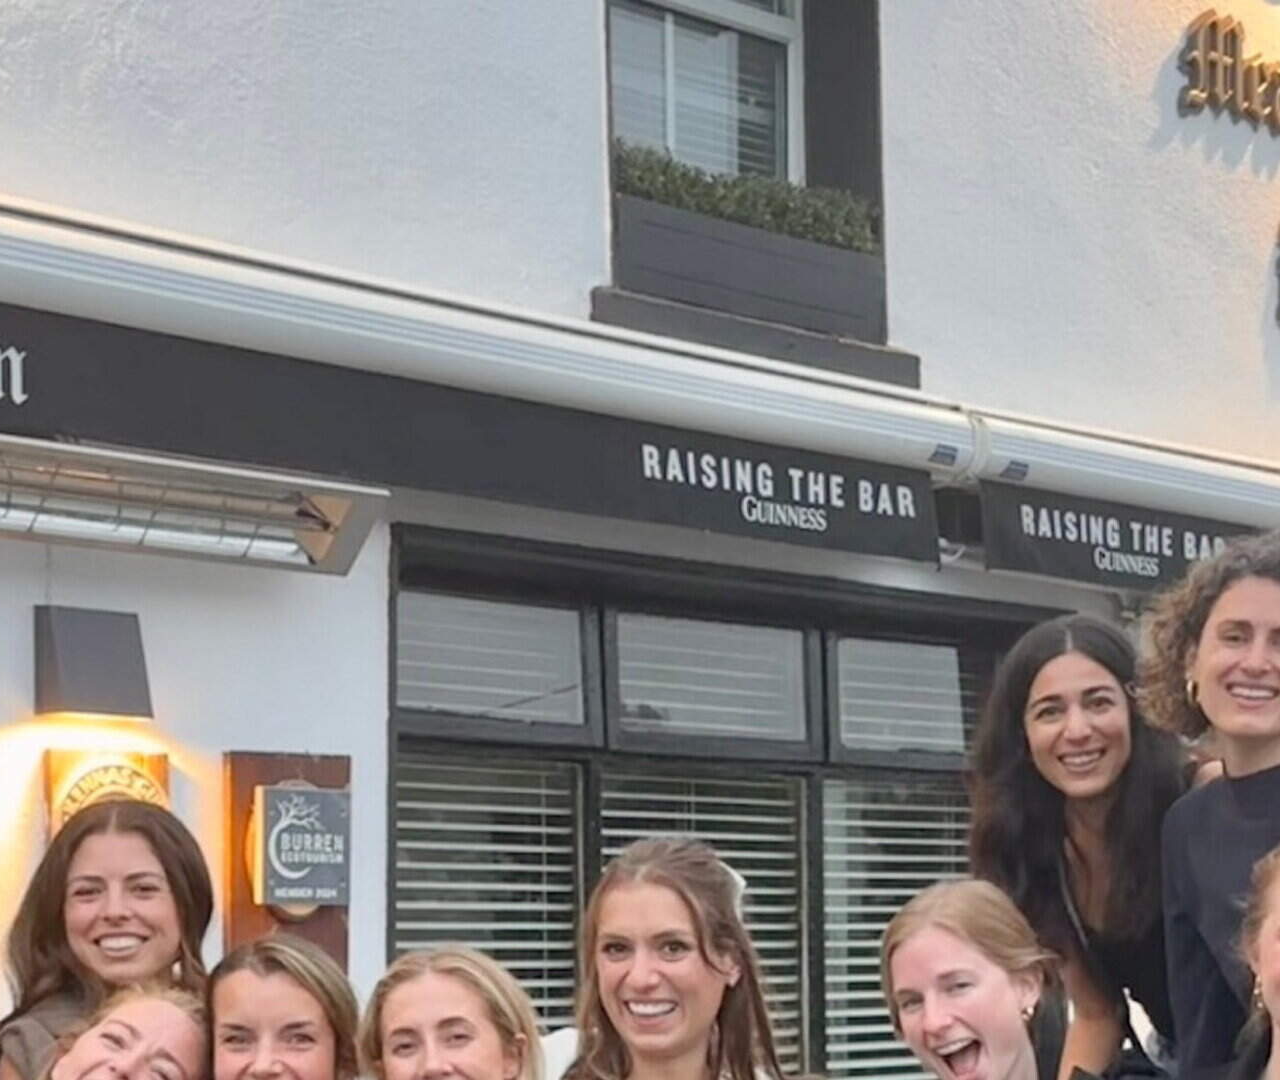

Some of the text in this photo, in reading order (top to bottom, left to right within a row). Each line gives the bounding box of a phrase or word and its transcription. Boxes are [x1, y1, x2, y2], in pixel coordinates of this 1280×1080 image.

[641, 444, 917, 518] RAISING THE BAR
[740, 495, 828, 531] GUINNESS
[1021, 504, 1120, 549] RAISING
[1129, 521, 1174, 556] THE
[1094, 546, 1160, 577] GUINNESS
[280, 832, 344, 852] BURREN
